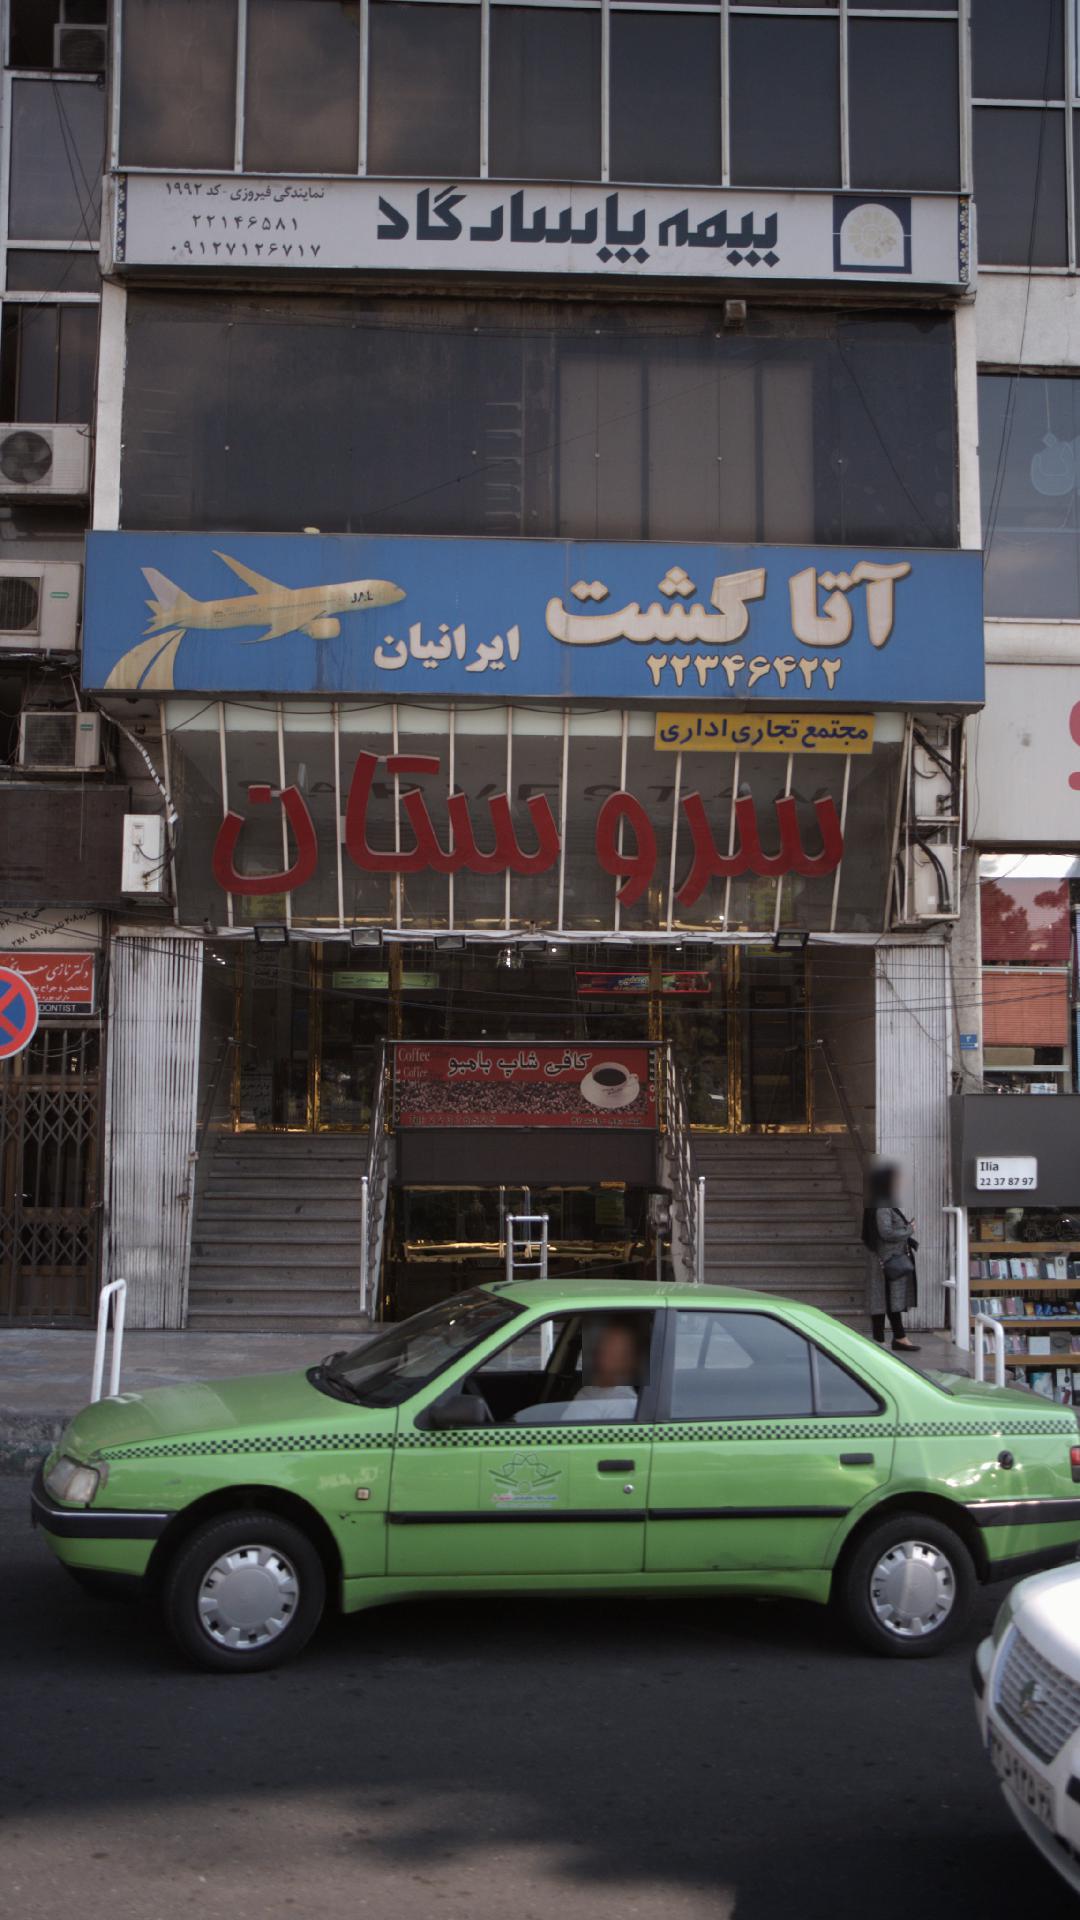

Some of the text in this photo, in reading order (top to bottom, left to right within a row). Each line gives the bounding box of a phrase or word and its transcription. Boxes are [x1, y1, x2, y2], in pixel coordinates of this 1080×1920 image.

[206, 184, 221, 197] کد
[230, 186, 272, 202] فیروزی
[273, 187, 325, 203] نمایندگی
[376, 185, 780, 268] بیمه پاسارگاد
[788, 560, 913, 649] آتا
[373, 621, 521, 673] ایرانیان
[645, 654, 842, 690] ۲۲۳۴۶۴۲۲
[660, 716, 868, 750] مجتمع تجاری اداری
[212, 749, 844, 909] سروستان
[66, 954, 92, 982] دکتر
[398, 1047, 431, 1062] Coffee
[496, 1050, 539, 1078] شاپ
[543, 1048, 593, 1077] کافی
[979, 1161, 1000, 1173] Ilia
[979, 1176, 1034, 1187] 22 37 87 97
